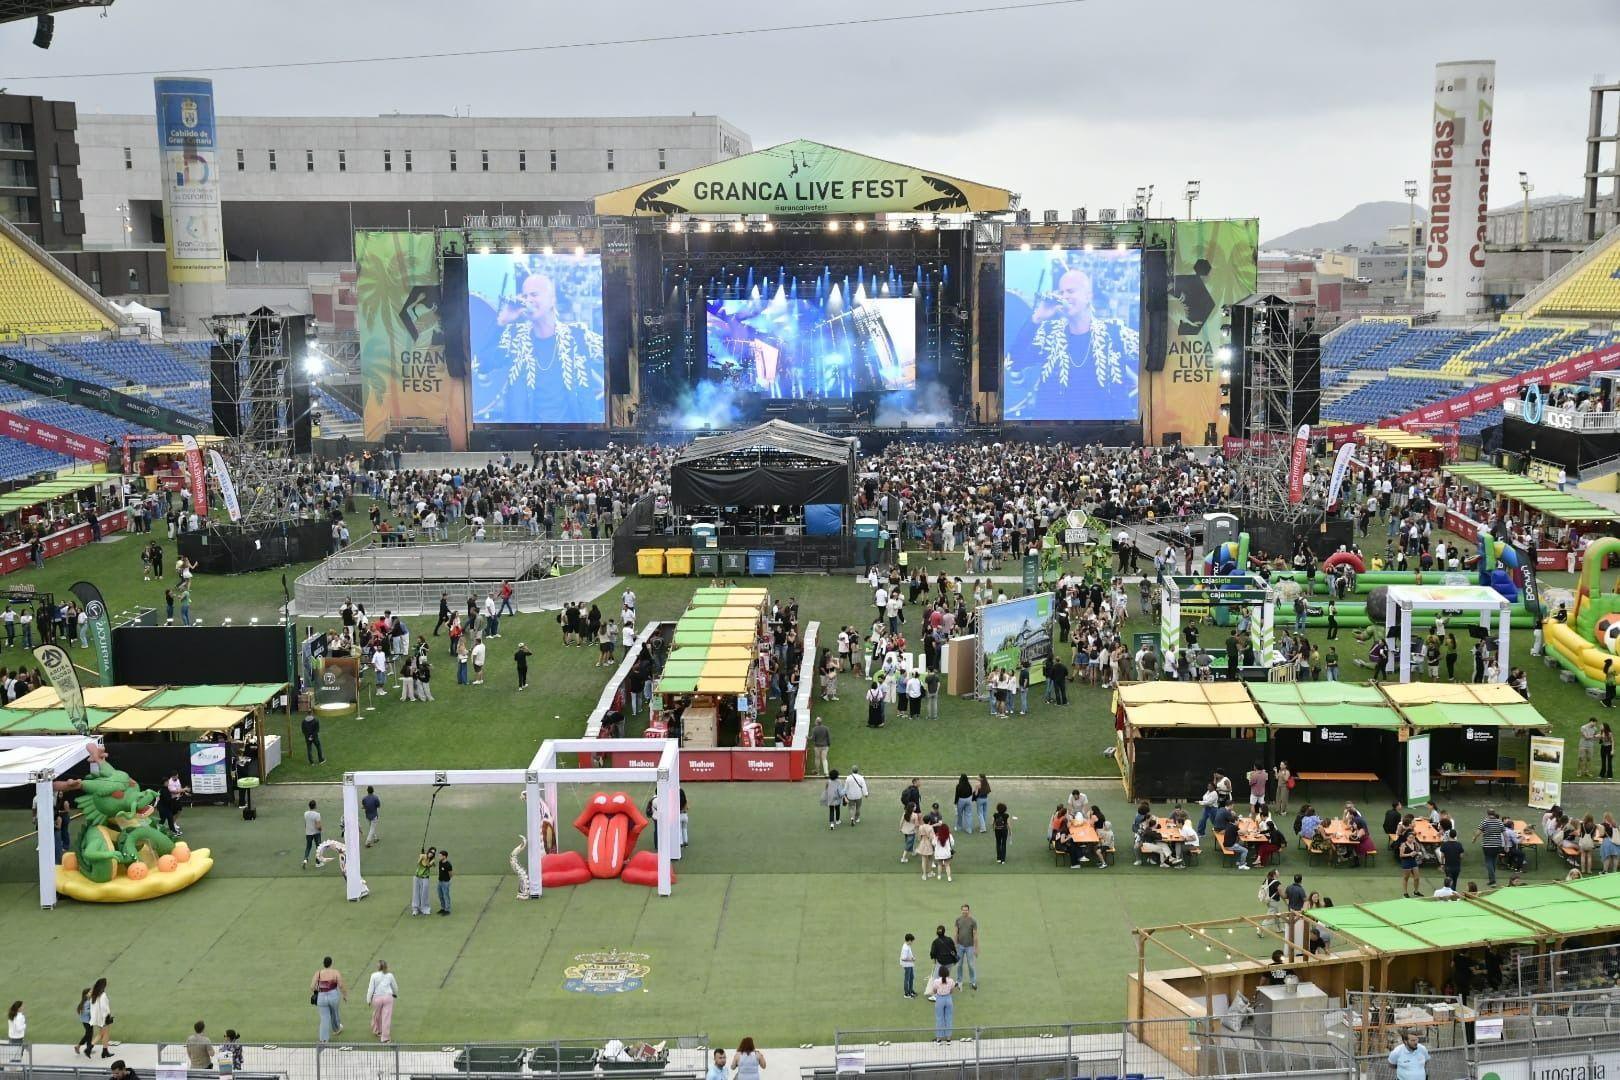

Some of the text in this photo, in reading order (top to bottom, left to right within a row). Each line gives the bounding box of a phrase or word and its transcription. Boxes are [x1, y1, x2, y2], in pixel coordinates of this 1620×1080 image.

[168, 136, 184, 144] Gran
[694, 179, 908, 200] GRANCA LIVE FEST
[775, 204, 828, 212] @grancalivefest
[1169, 340, 1213, 355] ANCA
[401, 350, 444, 364] GRAN
[1180, 355, 1214, 368] LIVE
[1574, 360, 1594, 370] Mahou
[402, 365, 436, 378] LIVE
[1173, 370, 1214, 383] FEST
[1549, 370, 1568, 379] Mahou
[402, 379, 442, 392] FEST
[1524, 376, 1544, 385] Mahou
[1500, 384, 1520, 393] Mahou
[1474, 392, 1494, 402] Mahou
[1450, 402, 1470, 411] Mahou
[1424, 410, 1444, 420] Mahou
[1548, 412, 1572, 429] IQOS
[37, 428, 58, 440] Mahou
[66, 438, 86, 450] Mahou
[628, 760, 654, 768] Mahou
[689, 760, 715, 768] Mahou
